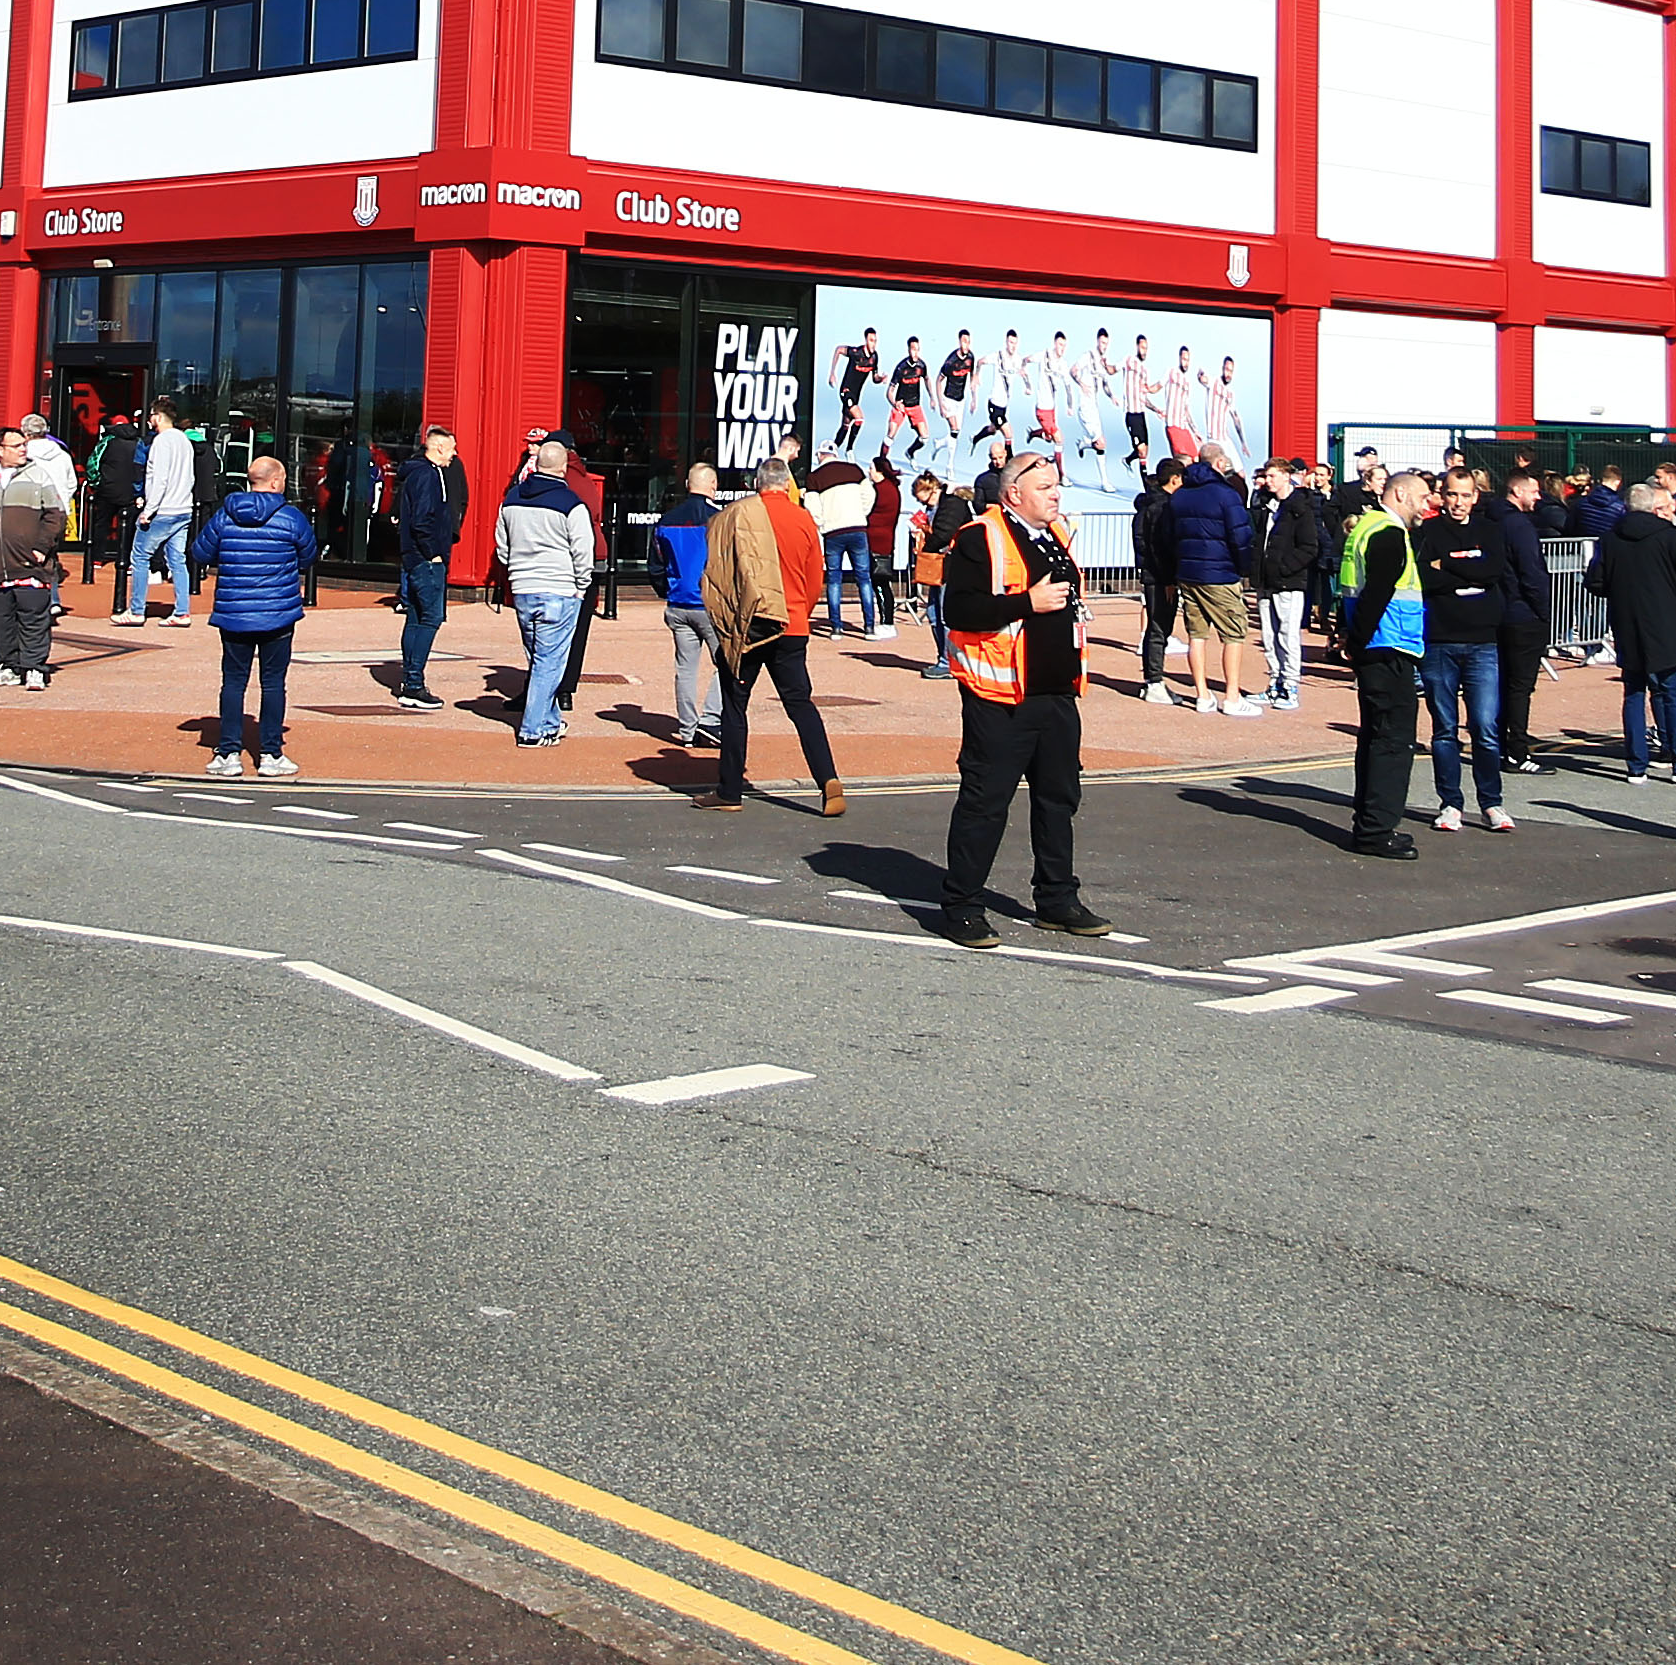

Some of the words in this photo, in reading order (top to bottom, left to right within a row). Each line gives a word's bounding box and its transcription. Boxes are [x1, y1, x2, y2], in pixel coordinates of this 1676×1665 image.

[421, 183, 486, 206] macron
[496, 182, 581, 210] macron
[616, 191, 671, 224] Club
[676, 197, 740, 231] Store
[45, 209, 78, 236] Club
[81, 208, 123, 234] Store
[715, 323, 798, 373] PLAY
[714, 371, 799, 422] YOUR
